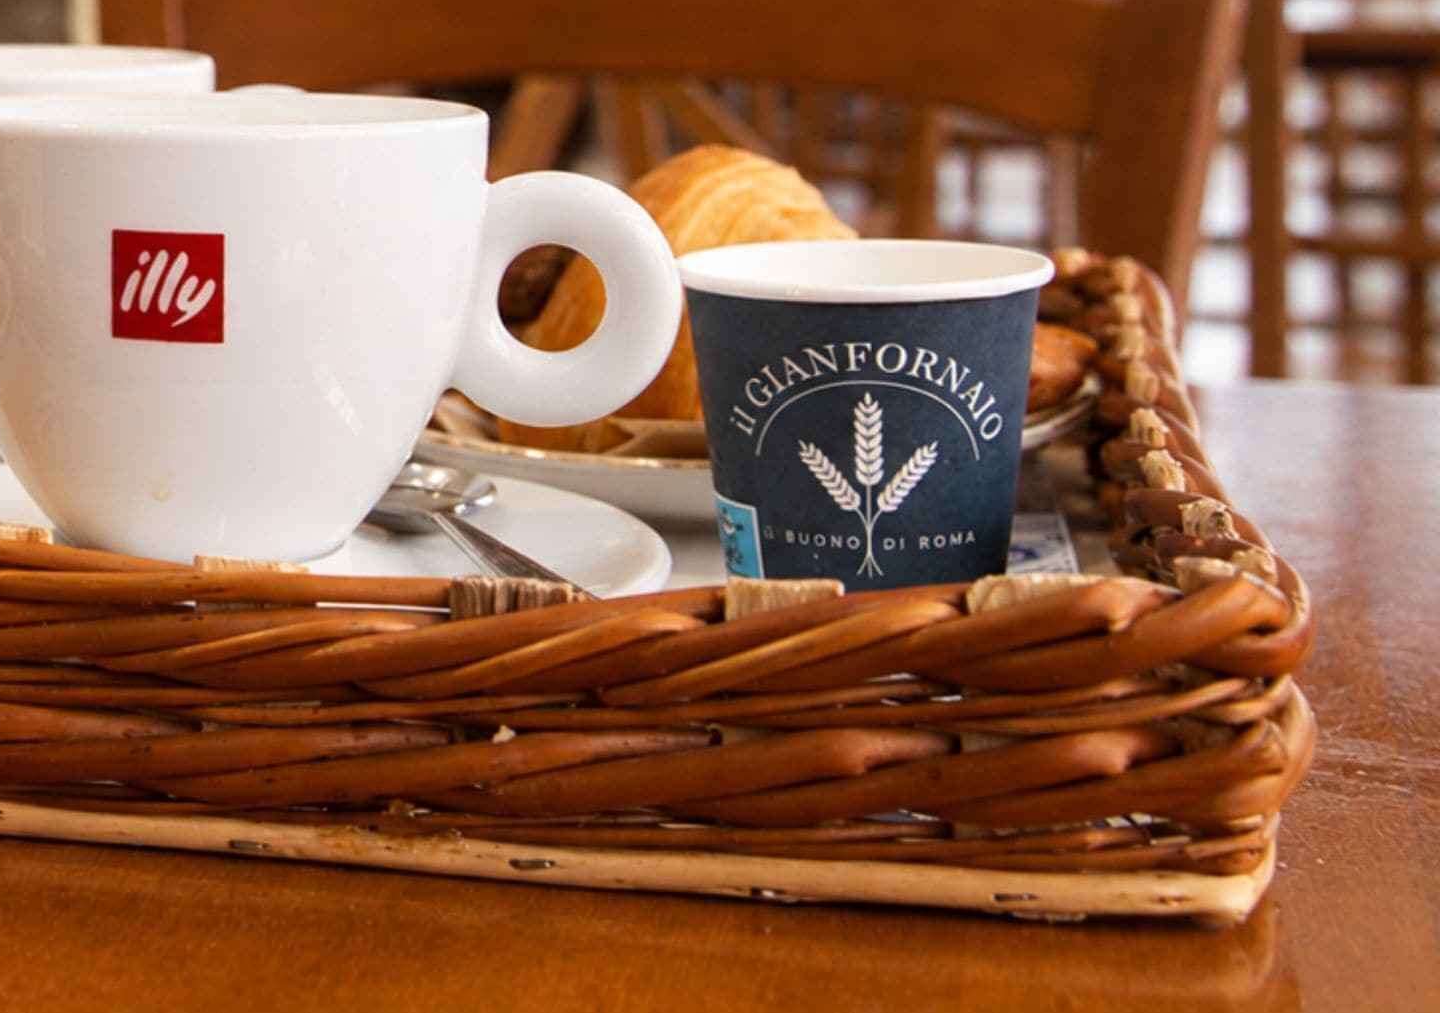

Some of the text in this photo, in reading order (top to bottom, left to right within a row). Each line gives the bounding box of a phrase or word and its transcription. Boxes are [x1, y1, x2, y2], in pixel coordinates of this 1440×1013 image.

[120, 249, 216, 327] illy
[745, 342, 1003, 441] GIANFORNAIO
[785, 529, 860, 550] BUONO
[883, 537, 905, 550] DI
[919, 530, 976, 549] ROMA
